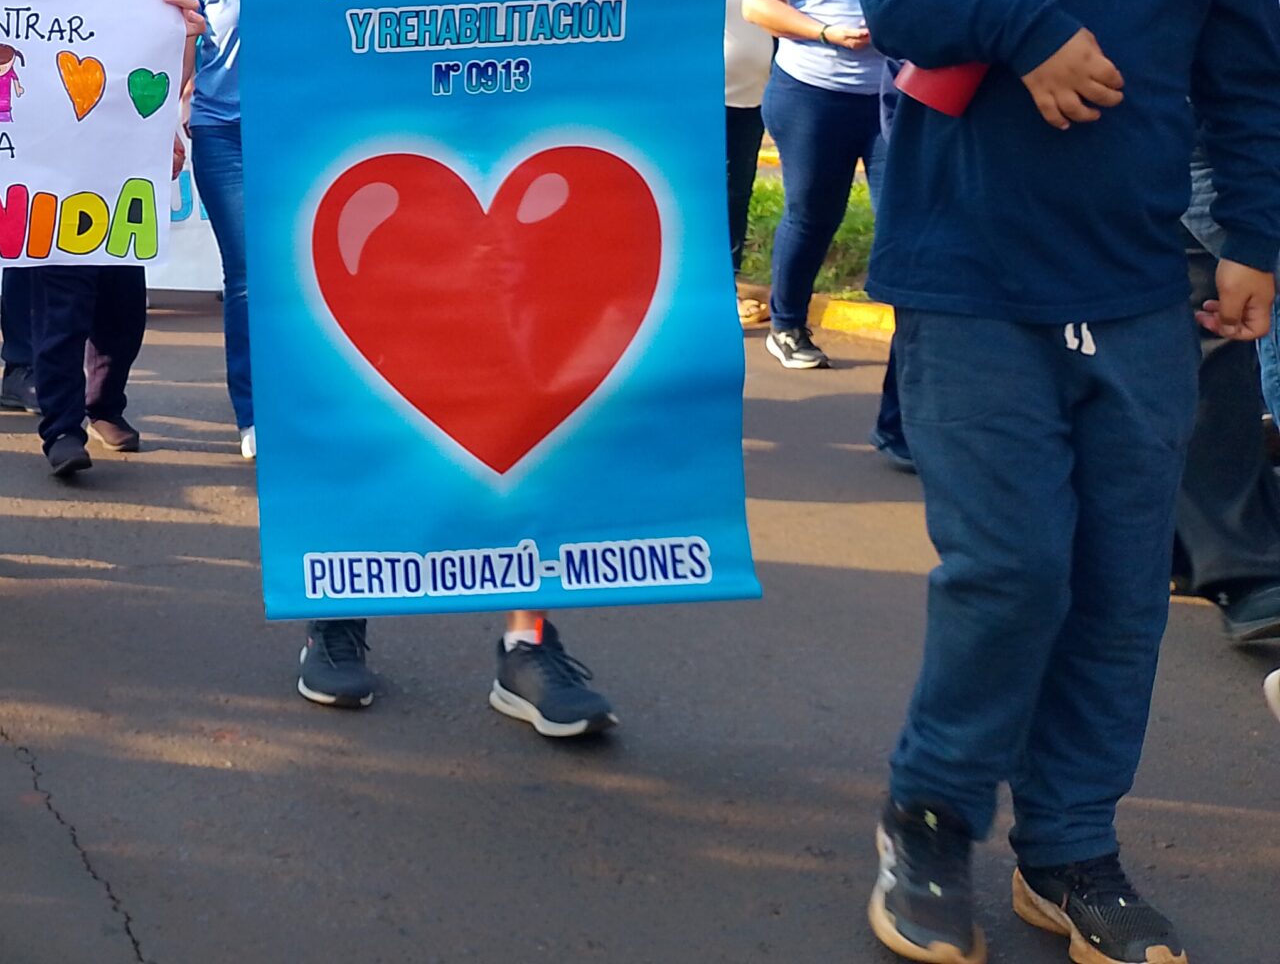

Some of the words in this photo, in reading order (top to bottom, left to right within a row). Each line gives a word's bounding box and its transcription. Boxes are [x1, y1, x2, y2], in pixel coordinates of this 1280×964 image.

[349, 11, 373, 50] Y
[466, 58, 531, 92] 0913
[309, 556, 422, 596] PUERTO
[429, 544, 536, 592] IGUAZÚ
[565, 542, 708, 586] MISIONES
